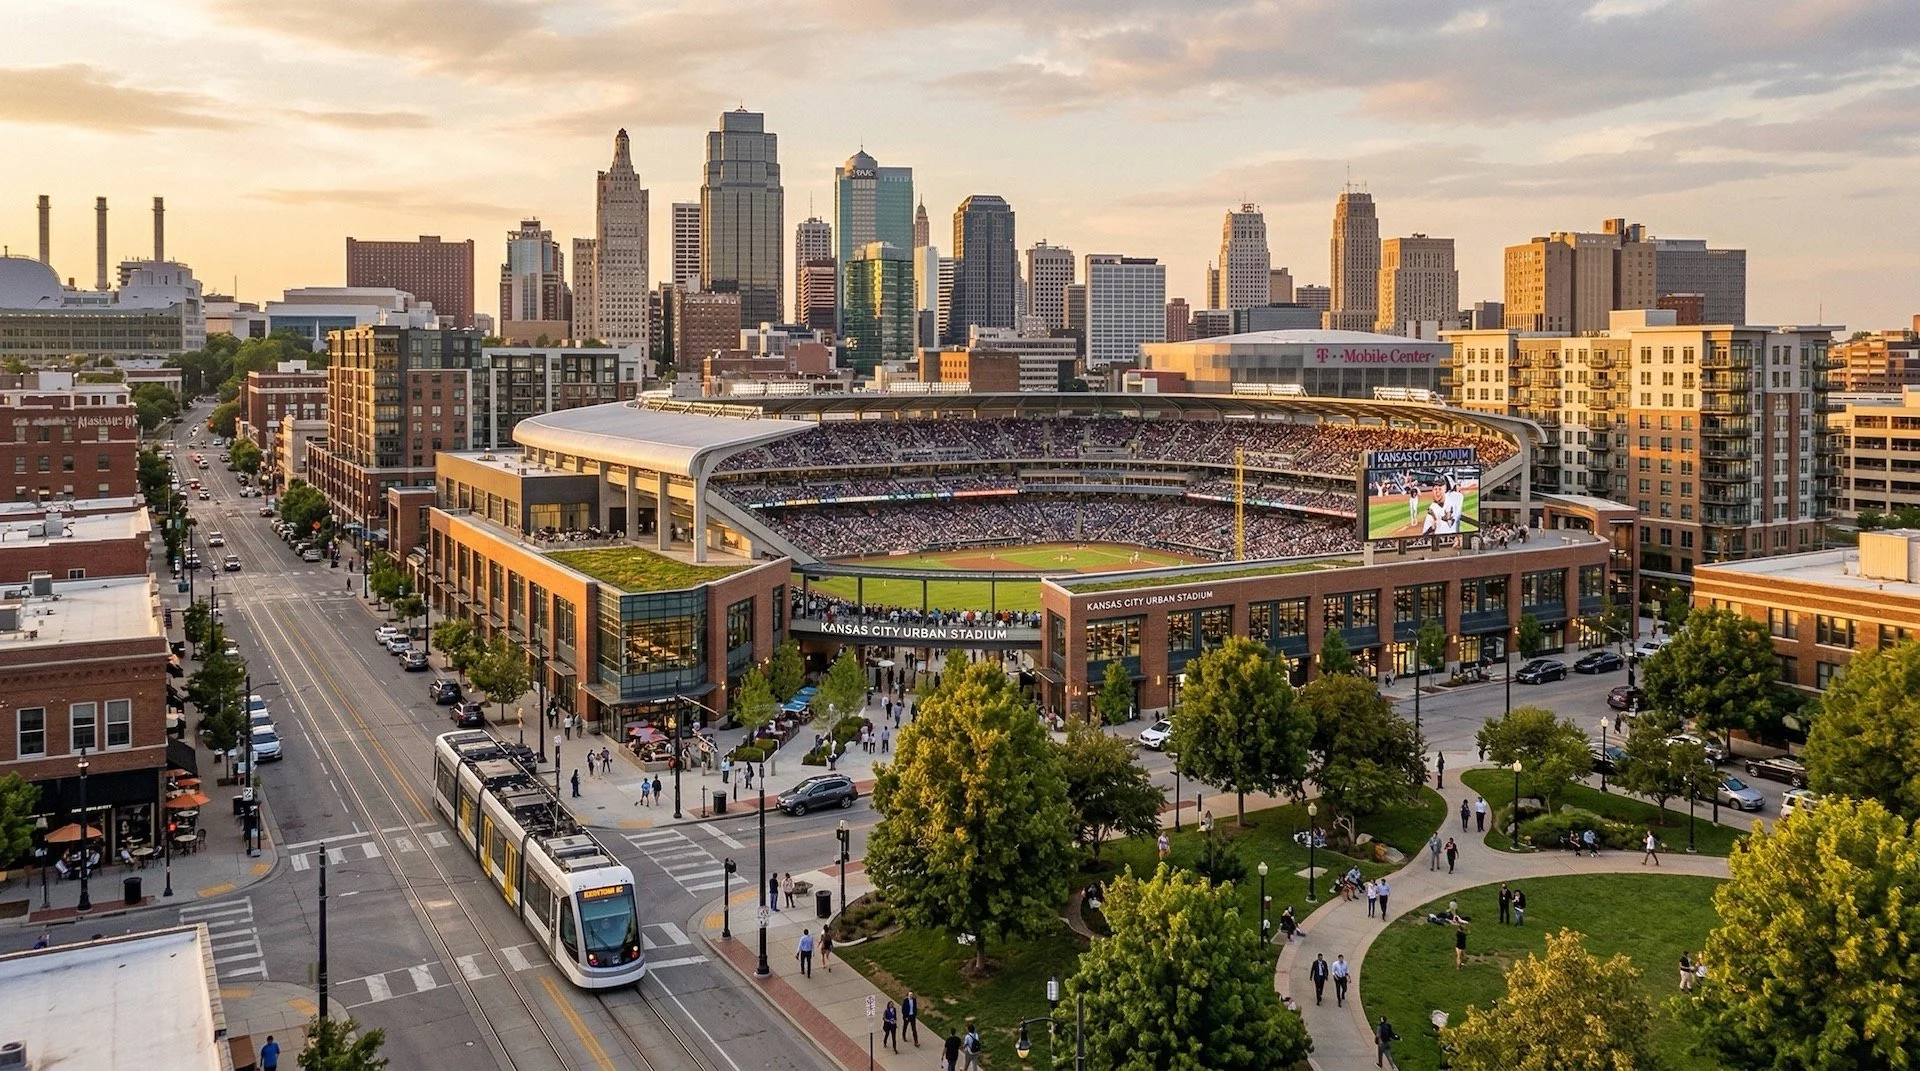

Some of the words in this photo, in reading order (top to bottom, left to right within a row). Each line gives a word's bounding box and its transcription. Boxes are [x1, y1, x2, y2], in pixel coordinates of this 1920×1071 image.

[1344, 348, 1388, 363] Mobile
[1390, 348, 1432, 363] Center
[1377, 452, 1412, 463] KANSAS
[1413, 451, 1434, 462] CITY
[1087, 599, 1122, 611] KANSAS
[1124, 597, 1144, 608] CITY
[1146, 594, 1175, 605] URBAN
[1177, 591, 1213, 602] STADIUM
[820, 622, 868, 636] KANSAS
[872, 626, 900, 637] CITY
[903, 627, 947, 639] URBAN
[950, 629, 1007, 640] STADIUM
